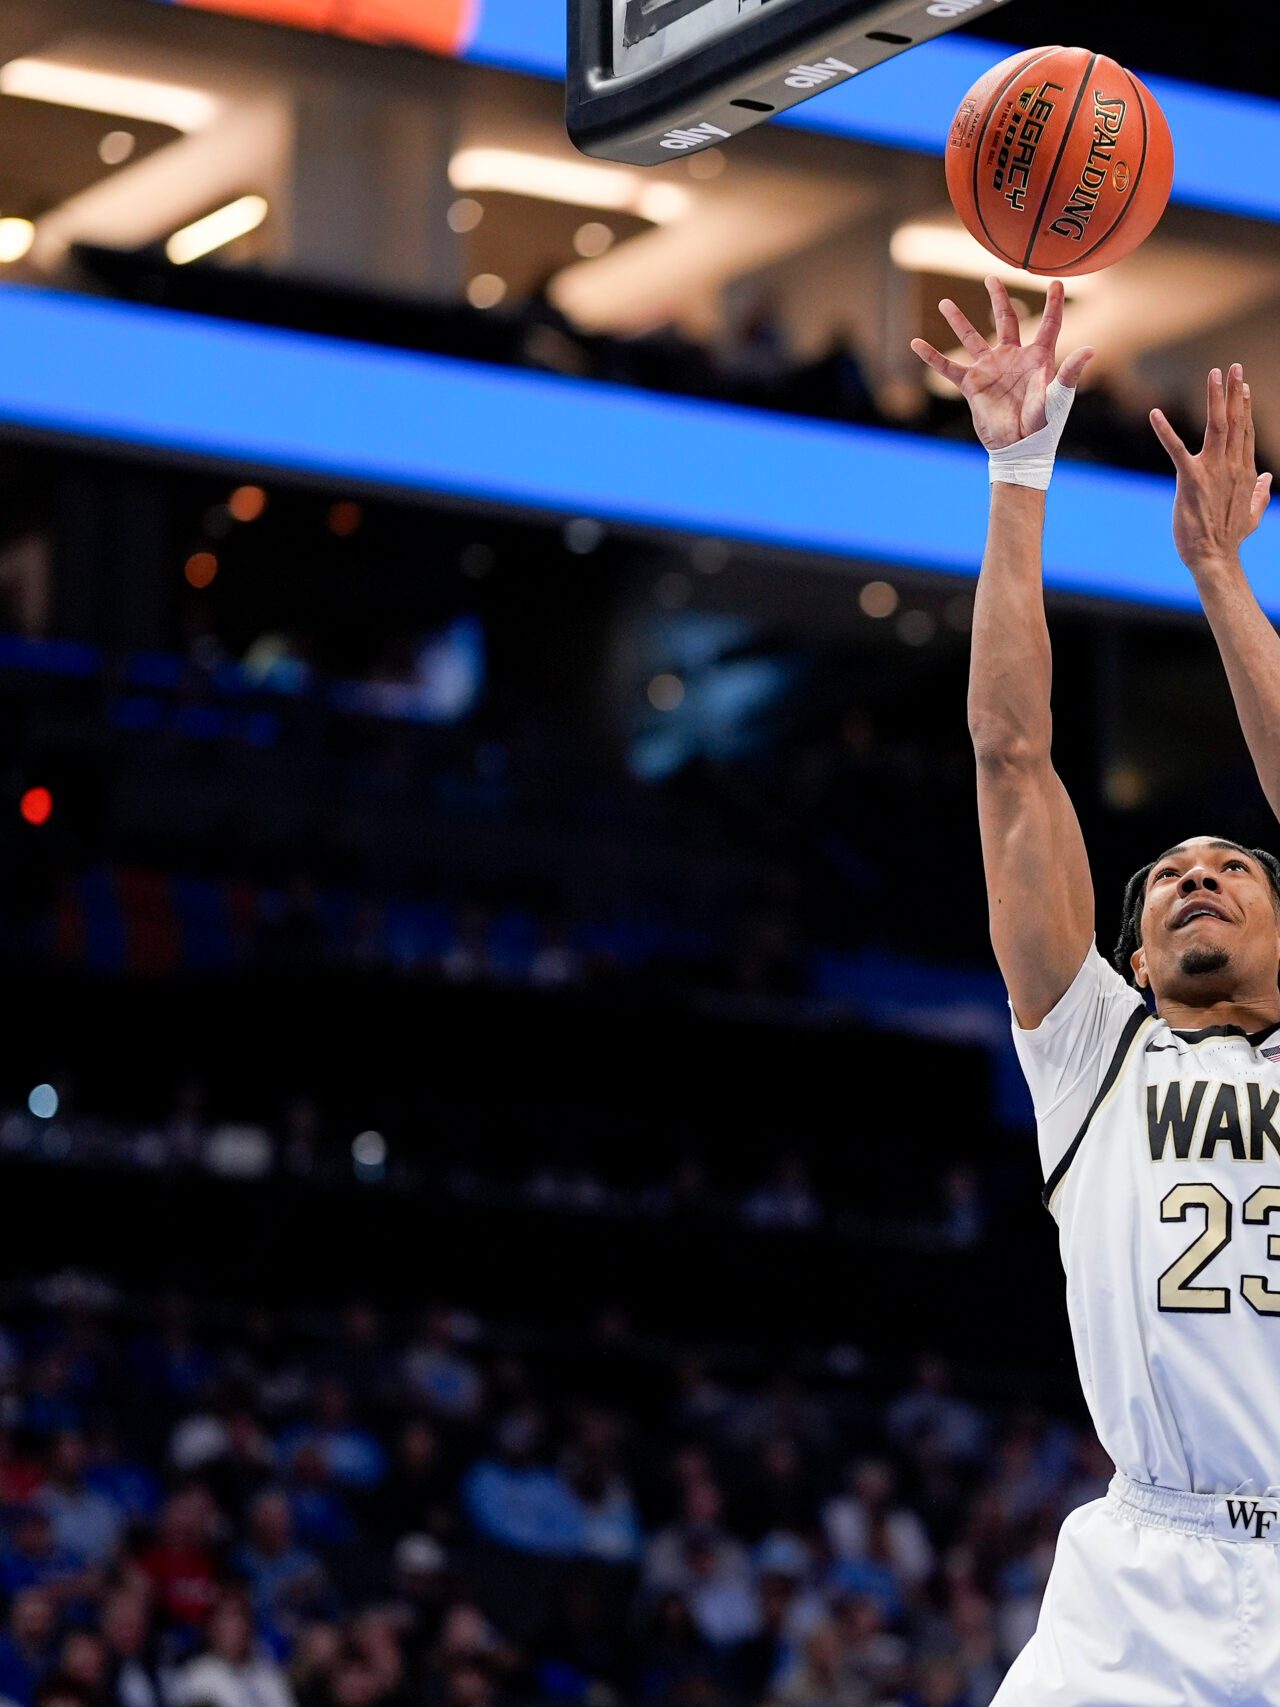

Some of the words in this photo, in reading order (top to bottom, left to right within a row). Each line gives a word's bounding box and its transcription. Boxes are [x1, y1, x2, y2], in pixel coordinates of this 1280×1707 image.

[784, 57, 858, 89] ally
[659, 122, 732, 151] ally
[1004, 81, 1065, 212] LEGACY
[1047, 88, 1127, 241] SPALDING
[1226, 1500, 1278, 1539] WF
